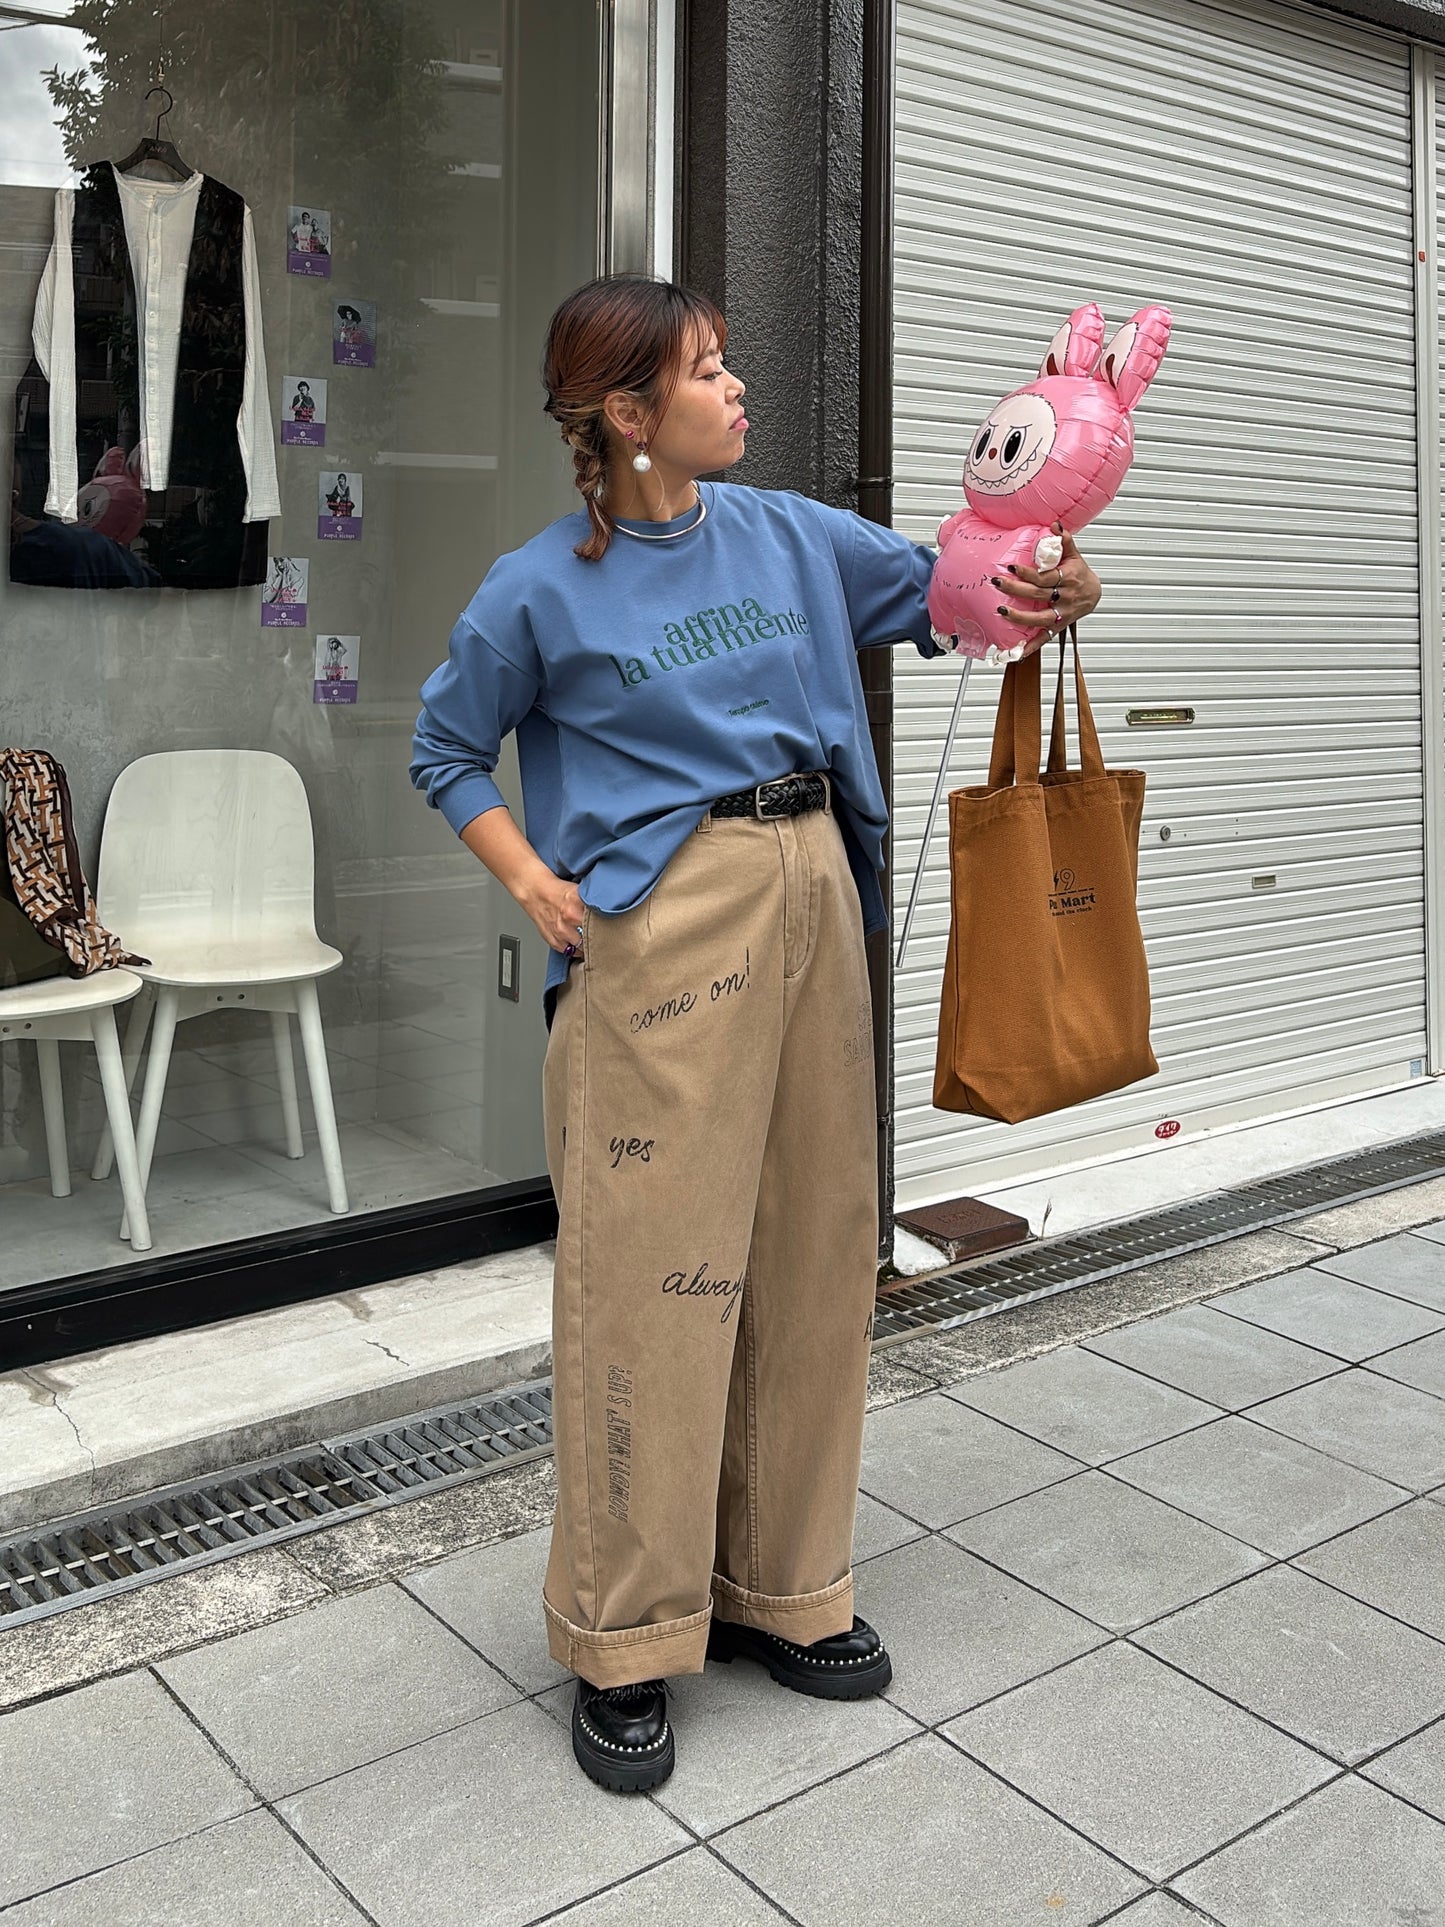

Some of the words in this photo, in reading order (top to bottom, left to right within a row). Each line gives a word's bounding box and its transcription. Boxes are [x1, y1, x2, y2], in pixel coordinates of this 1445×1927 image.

[608, 654, 652, 688] la
[650, 637, 719, 672] tua
[717, 607, 810, 653] mente
[663, 597, 766, 645] affina
[1060, 892, 1096, 908] Mart
[630, 992, 697, 1034] come
[710, 946, 750, 1002] on!
[609, 1136, 655, 1169] yes
[608, 1457, 632, 1523] HOWDY!
